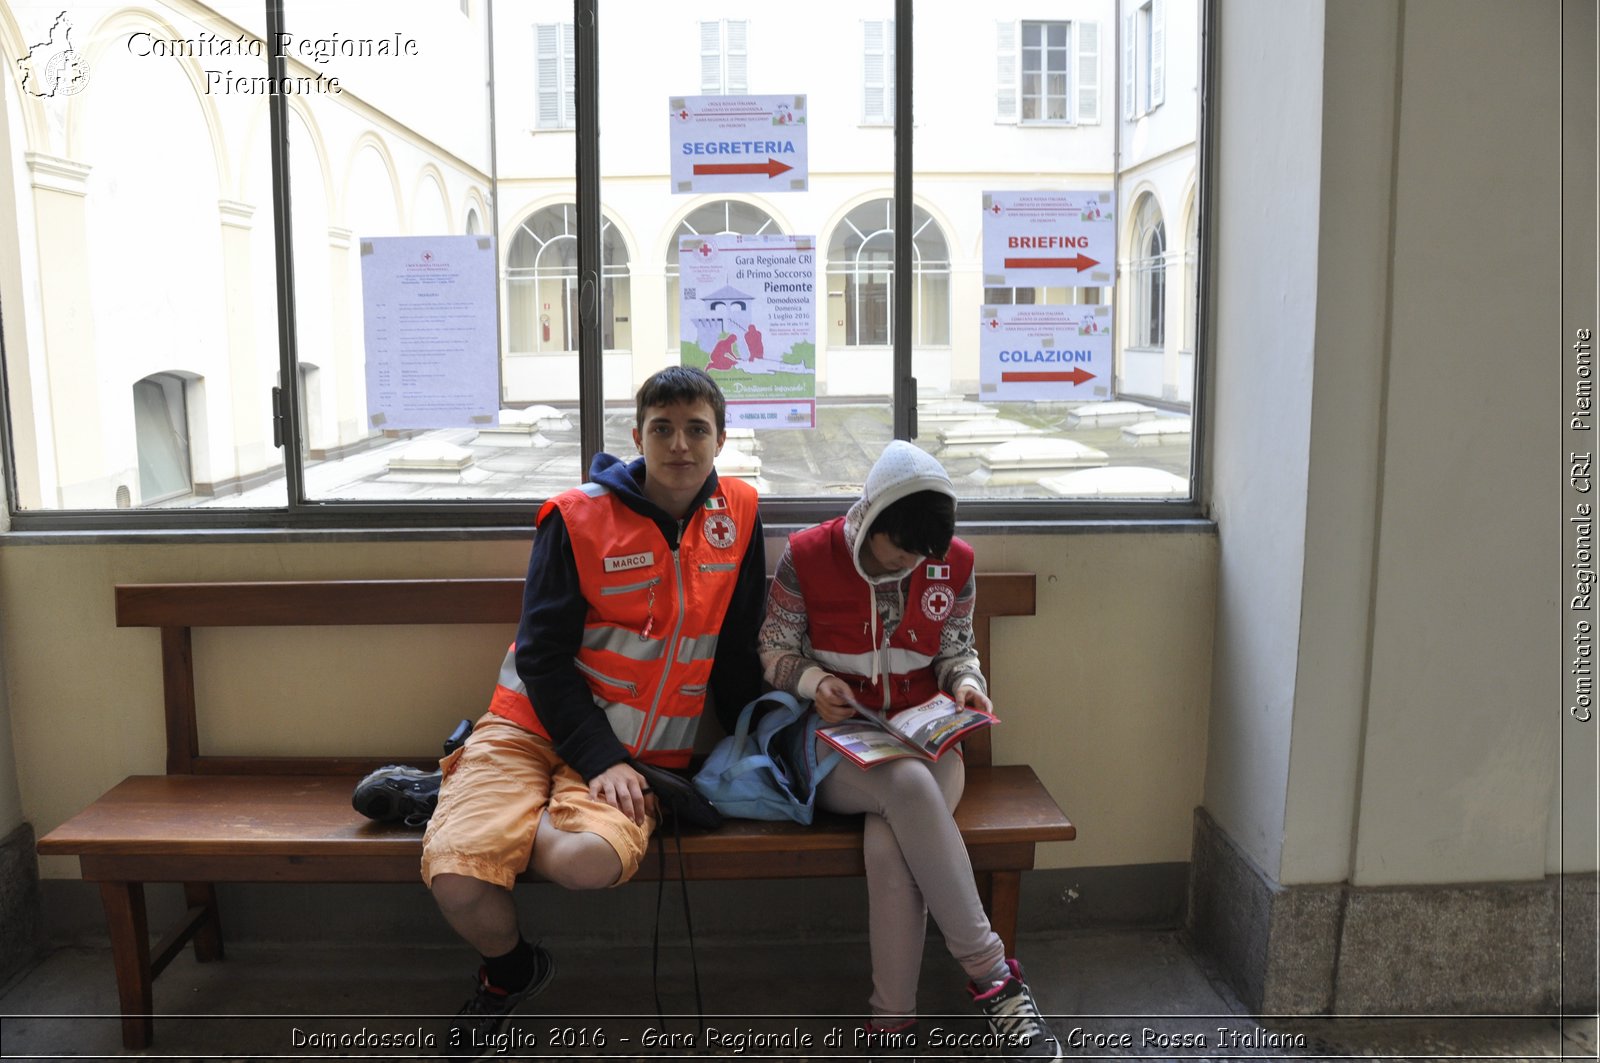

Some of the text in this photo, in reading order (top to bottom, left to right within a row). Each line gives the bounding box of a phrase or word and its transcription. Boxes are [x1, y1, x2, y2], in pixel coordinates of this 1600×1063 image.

[682, 141, 795, 155] SEGRETERIA
[1008, 236, 1089, 249] BRIEFING
[735, 255, 812, 267] Gara Regionale CRI
[736, 269, 812, 279] di Primo Soccorso
[764, 282, 812, 293] Piemonte
[766, 296, 810, 304] Domodossola
[773, 313, 793, 321] Luglio
[999, 350, 1092, 362] COLAZIONI
[613, 556, 645, 568] MARCO
